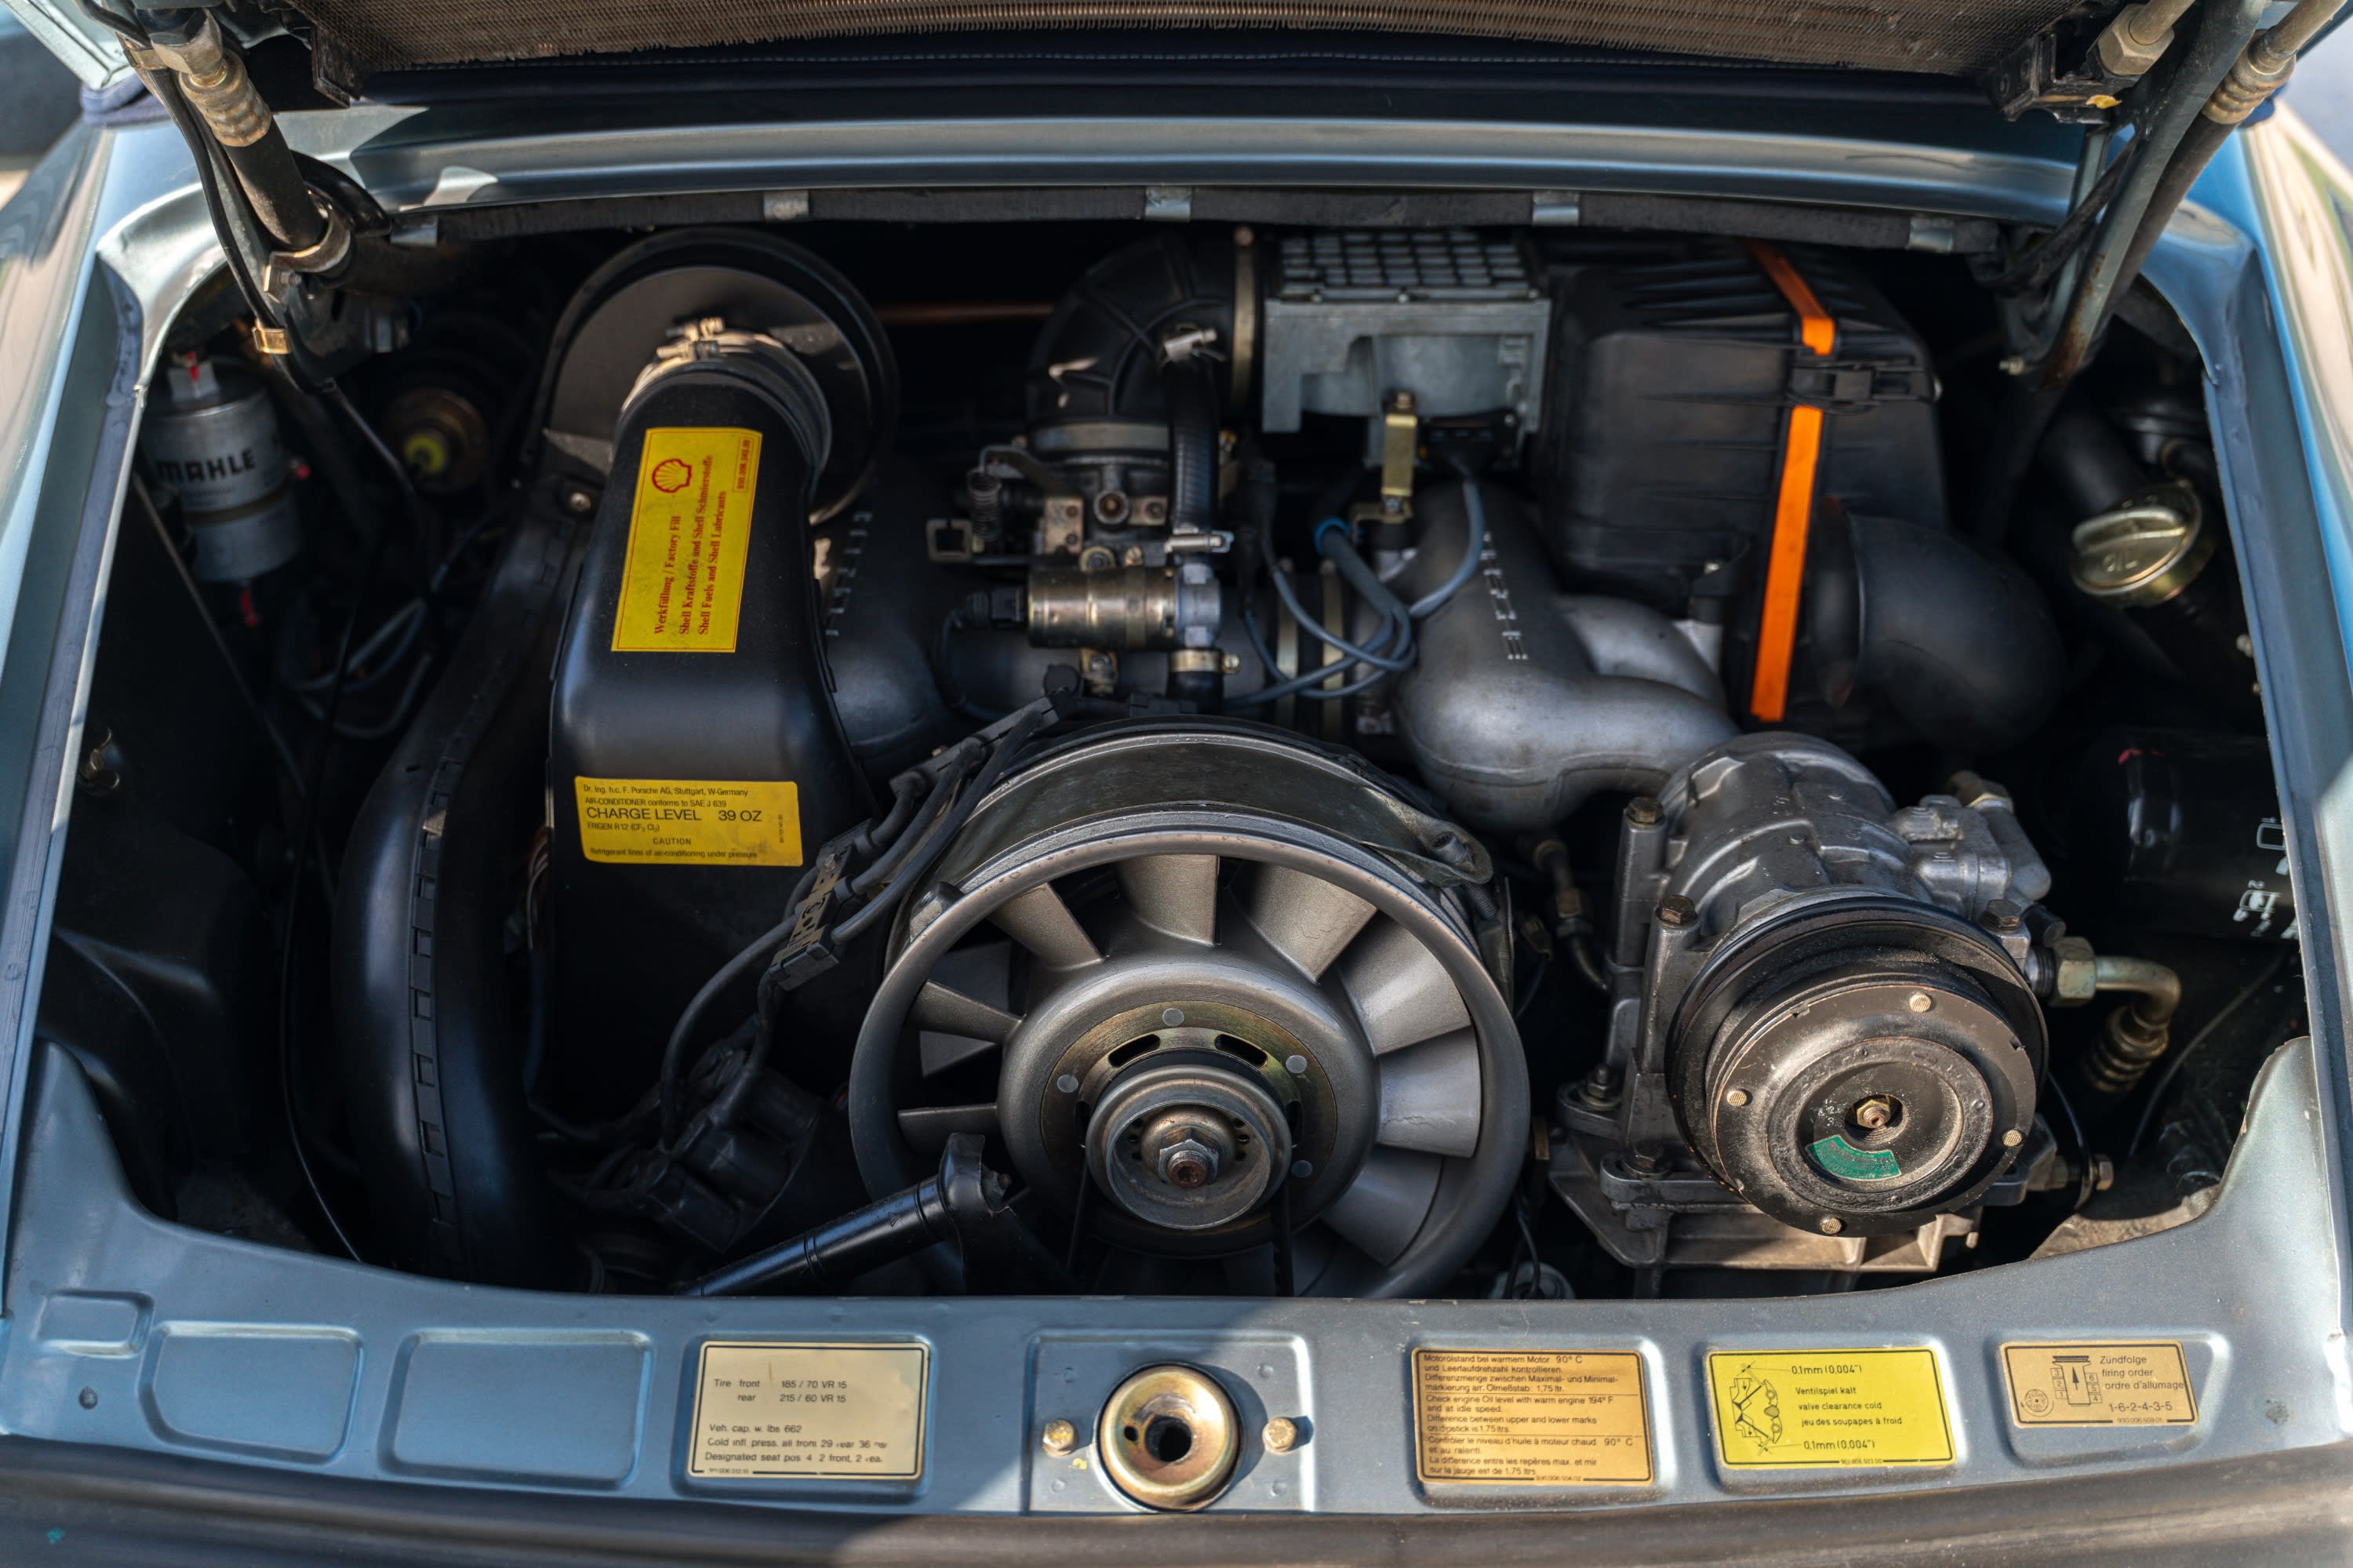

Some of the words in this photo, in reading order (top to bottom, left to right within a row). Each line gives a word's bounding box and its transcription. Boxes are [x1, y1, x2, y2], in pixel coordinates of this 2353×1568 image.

[157, 449, 256, 483] MAHLE
[696, 455, 713, 515] Schmierstoffe
[711, 491, 727, 537] Lubricants
[670, 515, 682, 532] Fill
[693, 516, 704, 540] Shell
[665, 534, 681, 568] Factory
[692, 541, 700, 559] und
[707, 540, 720, 563] Shell
[707, 566, 717, 584] and
[682, 560, 699, 608] Kraftstoffe
[701, 585, 713, 607] Fuels
[654, 577, 675, 634] Werkfüllung
[679, 609, 691, 635] Shell
[698, 609, 710, 635] Shell
[707, 788, 748, 797] W-Germany
[585, 797, 646, 806] AIR-CONDITIONER
[587, 806, 652, 820] CHARGE
[655, 809, 703, 820] LEVEL
[718, 809, 736, 821] 39
[740, 810, 762, 822] OZ
[2100, 1355, 2147, 1365] Zündfolge
[2102, 1370, 2125, 1378] firing
[714, 1379, 732, 1388] Tire
[739, 1379, 760, 1388] front
[781, 1380, 796, 1388] 185
[821, 1381, 835, 1389] VR
[1795, 1387, 1838, 1395] Ventilspiel
[2133, 1381, 2184, 1391] d'allumage
[780, 1393, 795, 1402] 215
[805, 1394, 817, 1402] 60
[820, 1394, 834, 1402] VR
[1426, 1394, 1450, 1402] Check
[1558, 1397, 1585, 1406] engine
[2109, 1401, 2173, 1413] 1-6-2-4-3-5
[1427, 1413, 1467, 1422] Difference
[1802, 1418, 1814, 1427] jeu
[784, 1424, 802, 1433] 662
[707, 1438, 729, 1446] Cold
[821, 1439, 833, 1448] 29
[860, 1439, 871, 1448] 36
[705, 1452, 757, 1462] Designated
